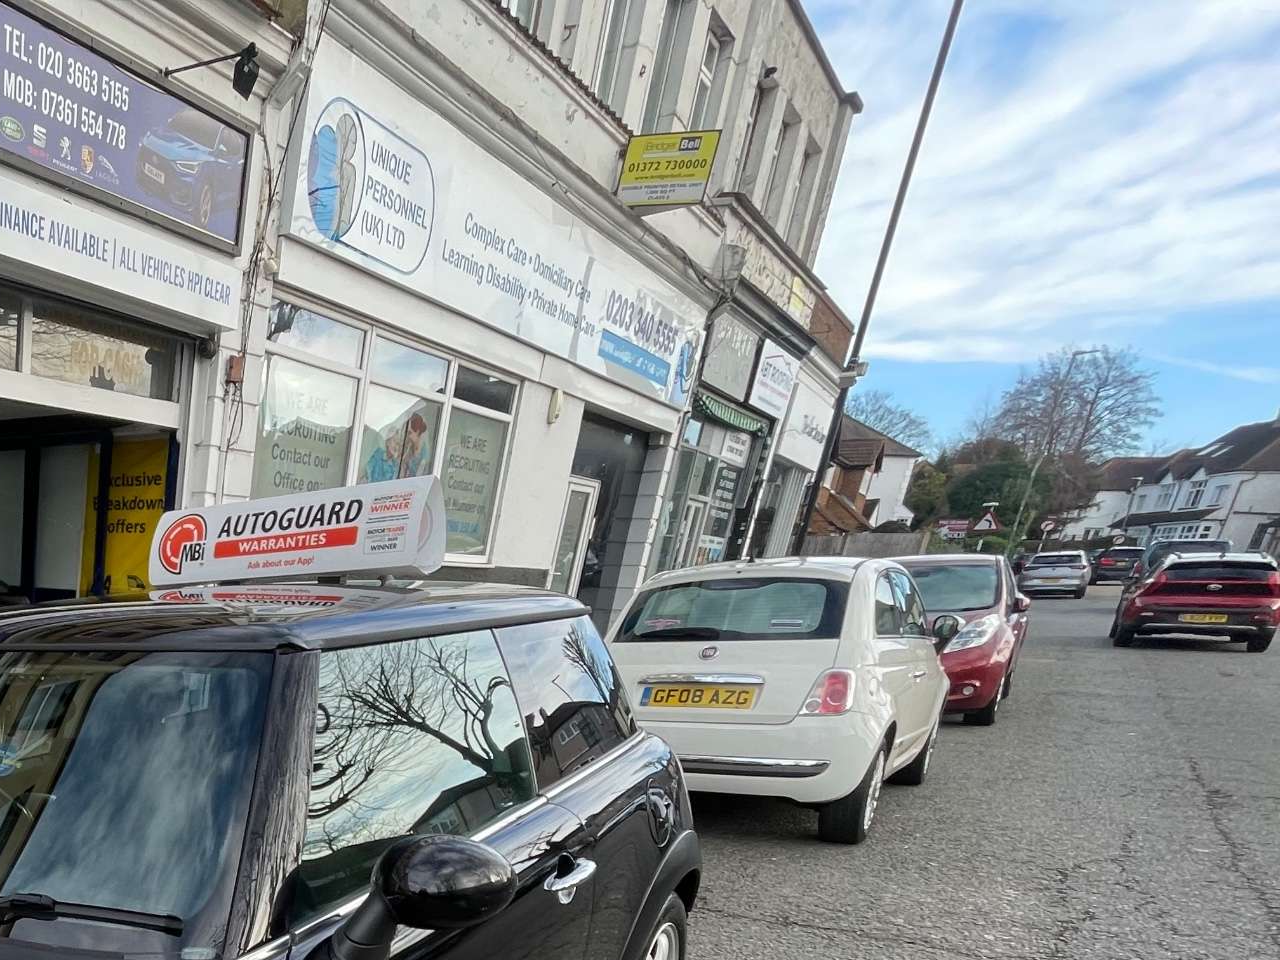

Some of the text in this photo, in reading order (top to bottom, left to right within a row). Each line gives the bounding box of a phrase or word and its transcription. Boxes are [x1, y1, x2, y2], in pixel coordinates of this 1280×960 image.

[4, 24, 130, 113] TEL: 020 3663 5155
[4, 69, 38, 110] MOB:
[41, 87, 79, 129] 07361
[81, 105, 104, 140] 554
[106, 118, 127, 150] 778
[680, 138, 701, 150] Bell
[371, 140, 412, 185] UNIQUE
[628, 158, 708, 173] 01372 730000
[365, 176, 428, 230] PERSONNEL
[360, 216, 406, 251] (UK) LTD
[49, 226, 110, 264] AVAILABLE
[120, 246, 140, 273] ALL
[141, 253, 186, 289] VEHICLES
[188, 271, 203, 295] HPI
[205, 276, 232, 306] CLEAR
[464, 212, 592, 304] Complex Care Domiciliary Care
[441, 239, 596, 338] Learning Disability Private Home Care
[606, 289, 635, 332] 0203
[633, 306, 655, 343] 340
[653, 319, 679, 355] 5555
[271, 443, 330, 469] Contact our
[472, 439, 488, 453] ARE
[448, 454, 490, 475] RECRUITING
[273, 471, 304, 491] Office
[370, 501, 410, 513] WINNER
[107, 519, 146, 534] offers
[218, 499, 363, 538] AUTOGUARD
[179, 541, 206, 563] MBi
[238, 532, 327, 554] WARRANTIES
[370, 542, 398, 552] WINNER
[247, 561, 260, 569] Ask
[261, 559, 282, 568] about
[284, 558, 296, 566] our
[653, 688, 750, 705] GF08 AZG
